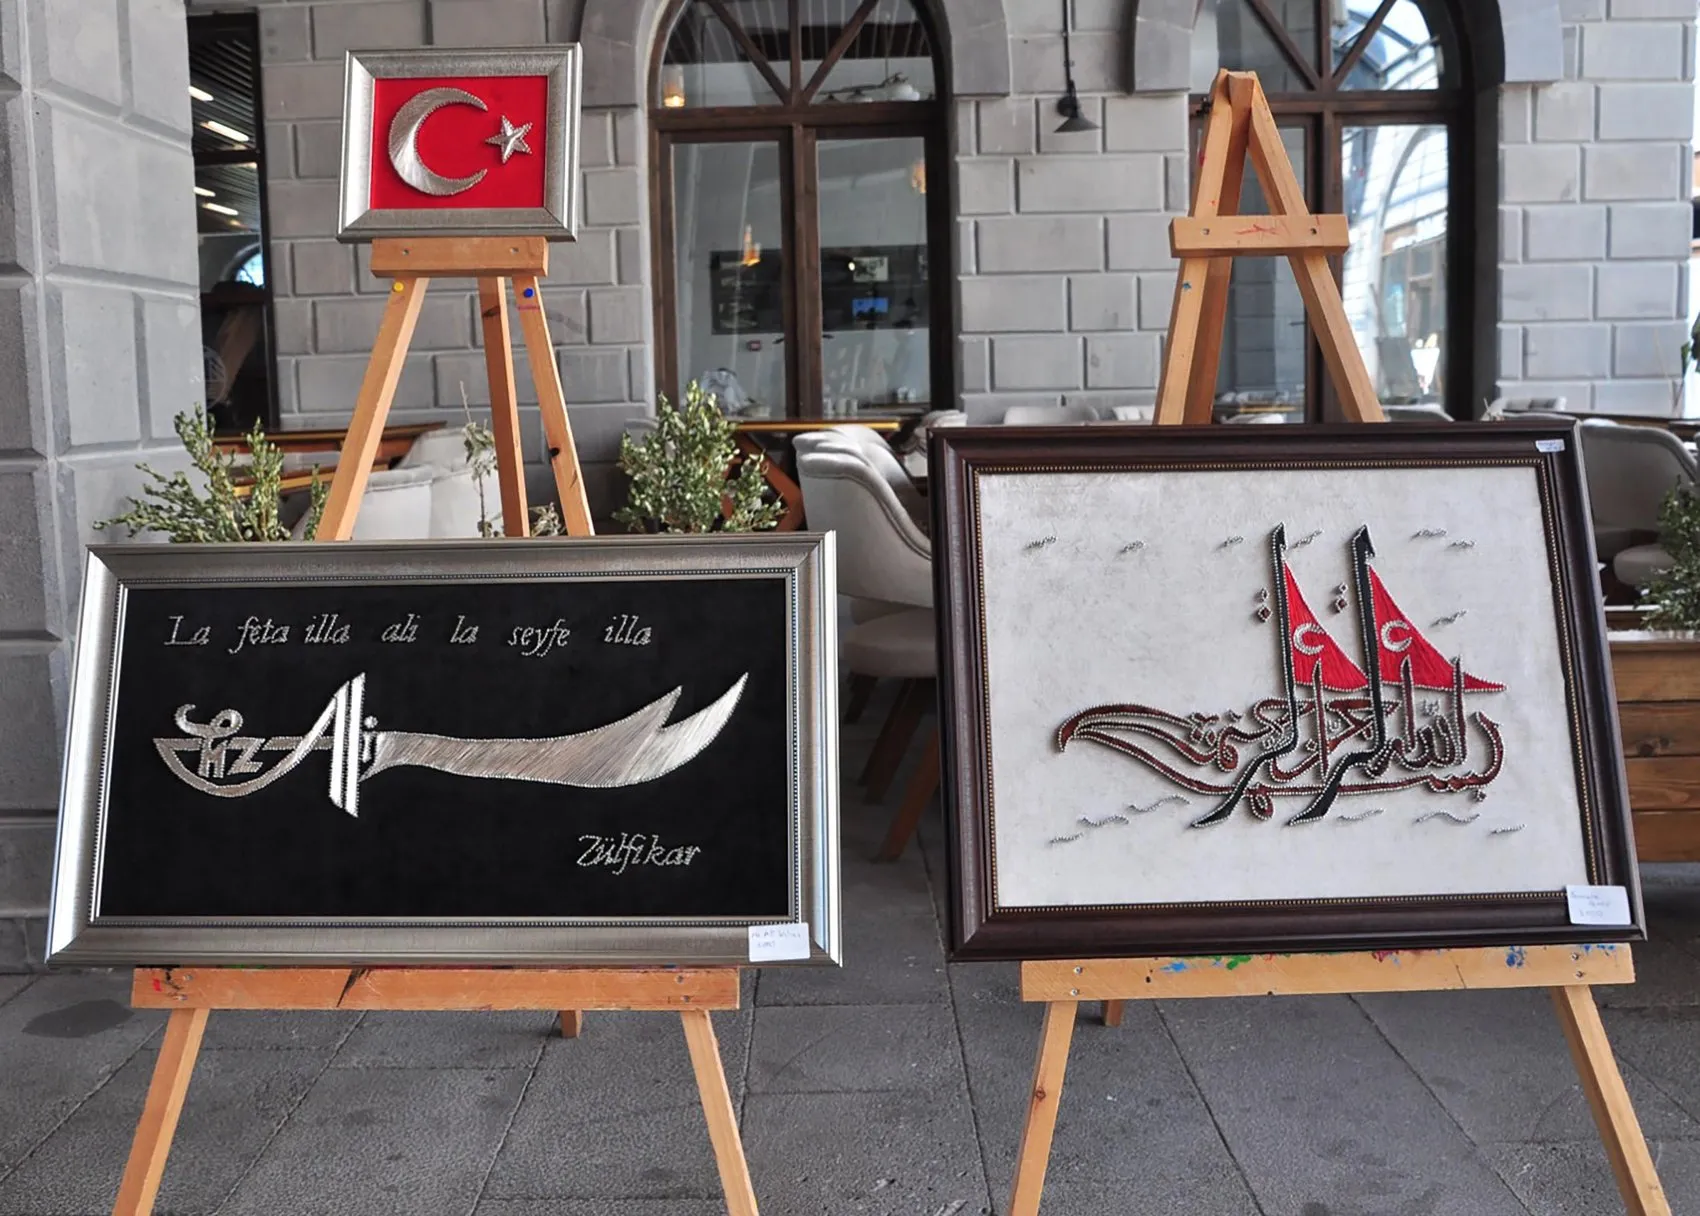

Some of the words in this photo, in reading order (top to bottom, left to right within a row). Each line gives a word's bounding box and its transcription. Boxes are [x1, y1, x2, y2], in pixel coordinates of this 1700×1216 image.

[165, 616, 210, 644] La
[229, 616, 289, 653] feta
[305, 614, 350, 643] illa
[382, 614, 420, 642] ali
[451, 616, 478, 643] la
[508, 619, 570, 657] seyfe
[605, 614, 651, 645] illa
[577, 833, 701, 875] Zülfikar
